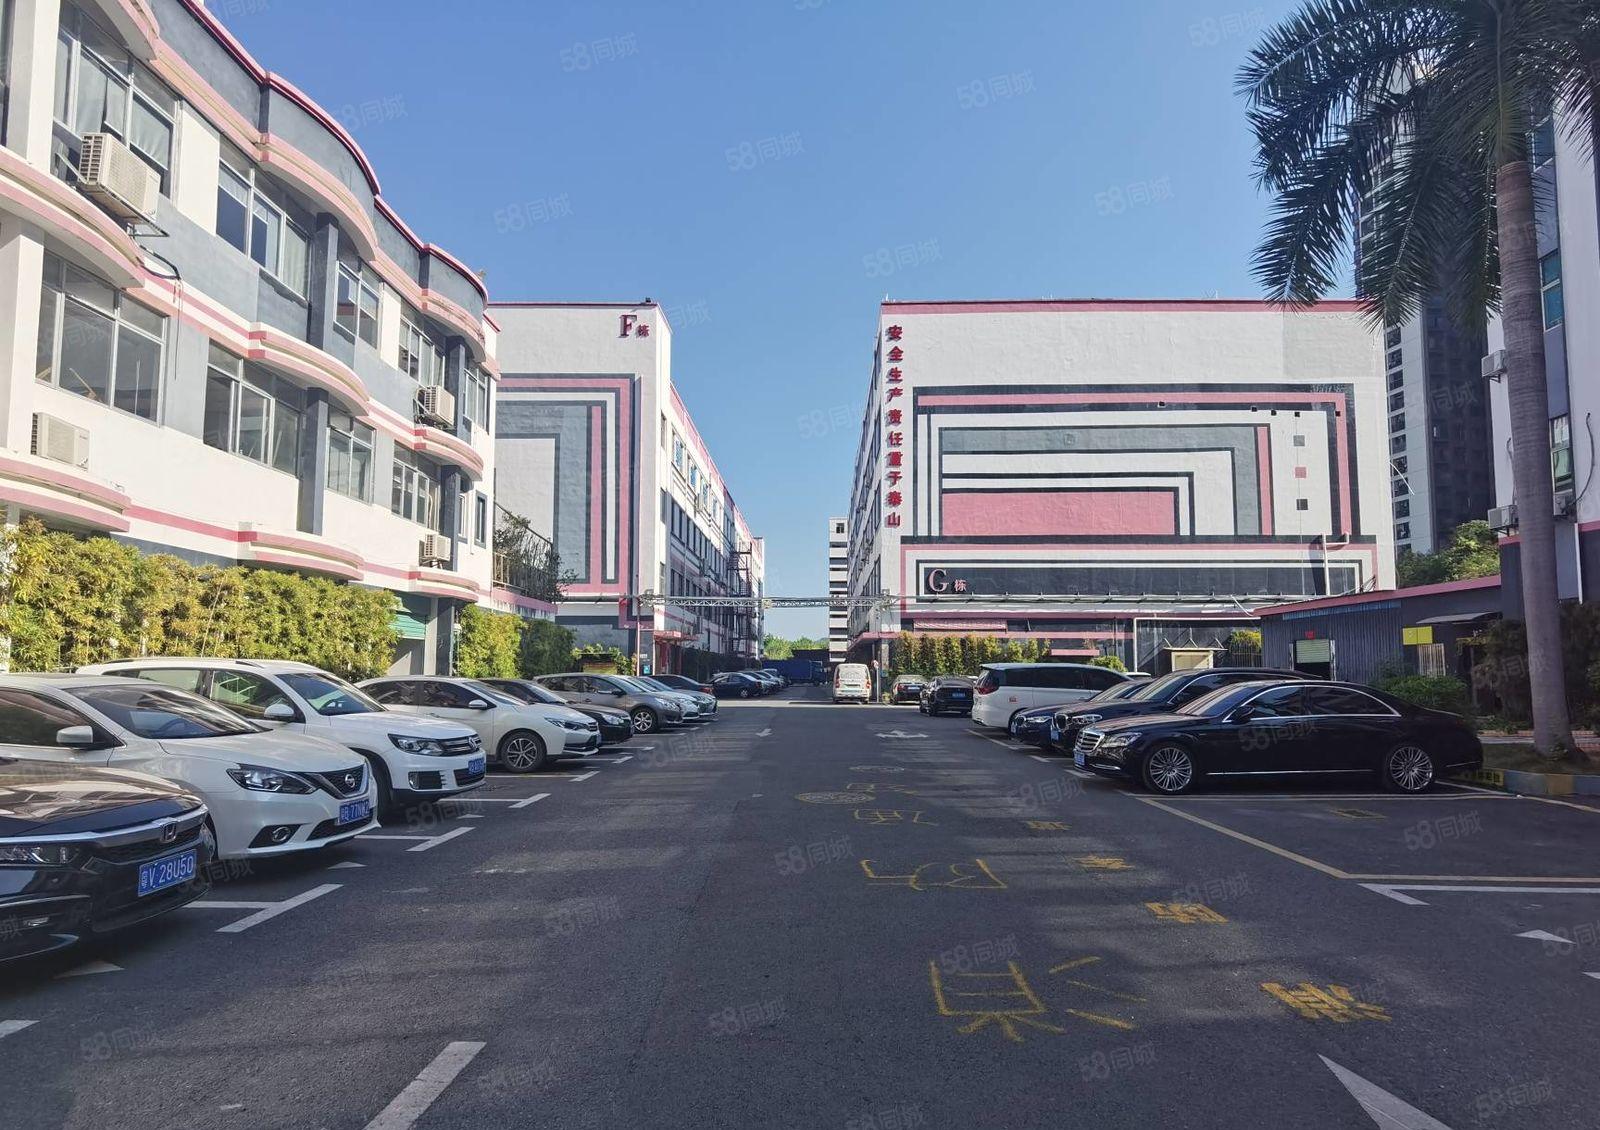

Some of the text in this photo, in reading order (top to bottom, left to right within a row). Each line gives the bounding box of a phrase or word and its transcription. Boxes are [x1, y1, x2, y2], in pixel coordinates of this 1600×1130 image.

[886, 324, 904, 528] 安全生产责任重于泰山
[928, 568, 967, 592] G栋
